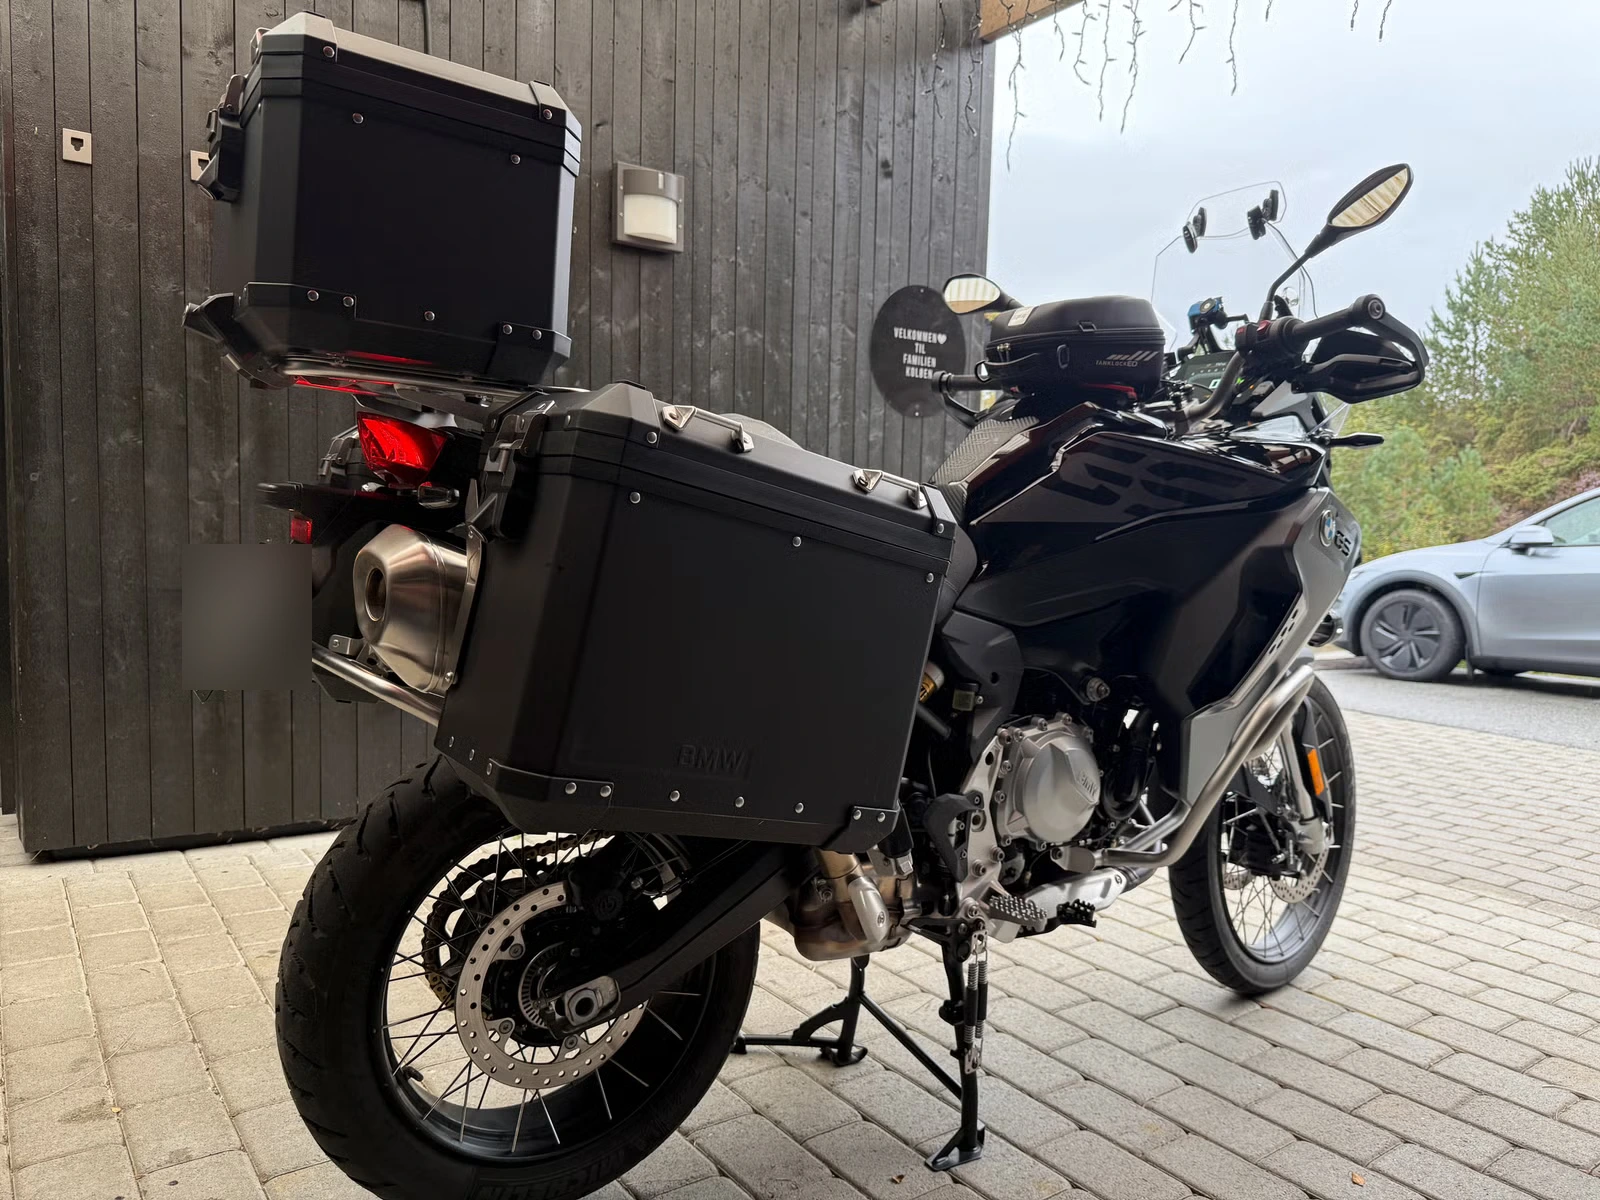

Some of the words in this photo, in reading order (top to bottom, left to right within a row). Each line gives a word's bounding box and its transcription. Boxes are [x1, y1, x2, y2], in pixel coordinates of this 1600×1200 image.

[894, 326, 937, 344] VELKOMMEN
[914, 342, 926, 354] TIL
[903, 353, 937, 368] FAMILIEN
[1334, 530, 1351, 557] GS
[676, 743, 750, 777] BMW
[1076, 770, 1099, 797] BMW
